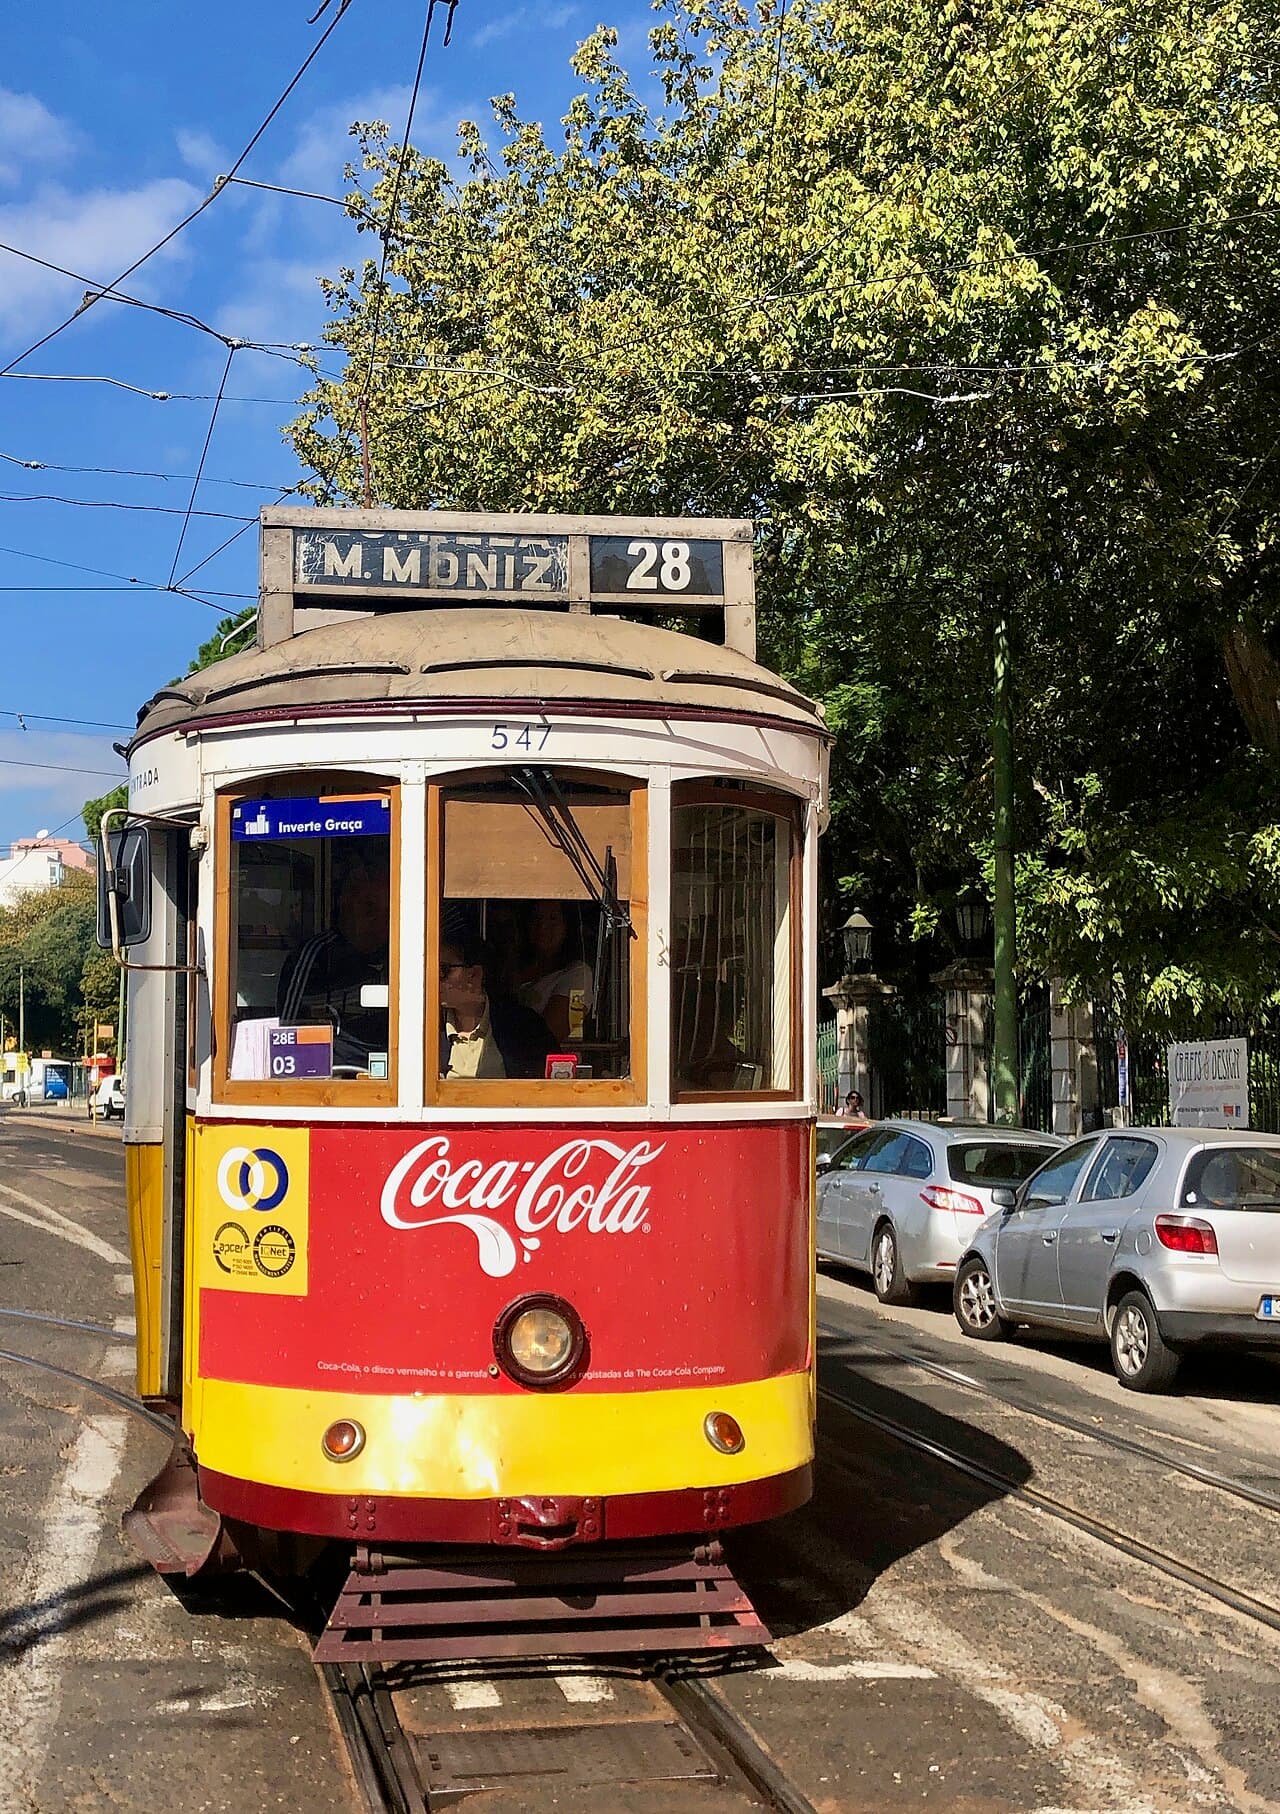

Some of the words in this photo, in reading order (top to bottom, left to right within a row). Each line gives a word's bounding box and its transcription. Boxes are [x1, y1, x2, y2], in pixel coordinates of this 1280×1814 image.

[324, 542, 372, 579] M.
[383, 546, 553, 590] MONIZ
[625, 540, 692, 591] 28
[492, 724, 553, 751] 547
[278, 821, 322, 833] Inverte
[325, 818, 363, 833] Graça
[272, 1032, 295, 1045] 28E
[272, 1056, 296, 1074] 03
[1212, 1048, 1241, 1081] DESIGN
[380, 1136, 667, 1278] Coca-Cola
[219, 1243, 243, 1255] apcer
[363, 1365, 370, 1373] o
[372, 1364, 395, 1375] disco
[397, 1366, 438, 1377] vermelho
[456, 1368, 488, 1380] garrafa
[624, 1369, 634, 1378] da
[636, 1368, 651, 1377] The
[653, 1367, 691, 1376] Coca-Cola
